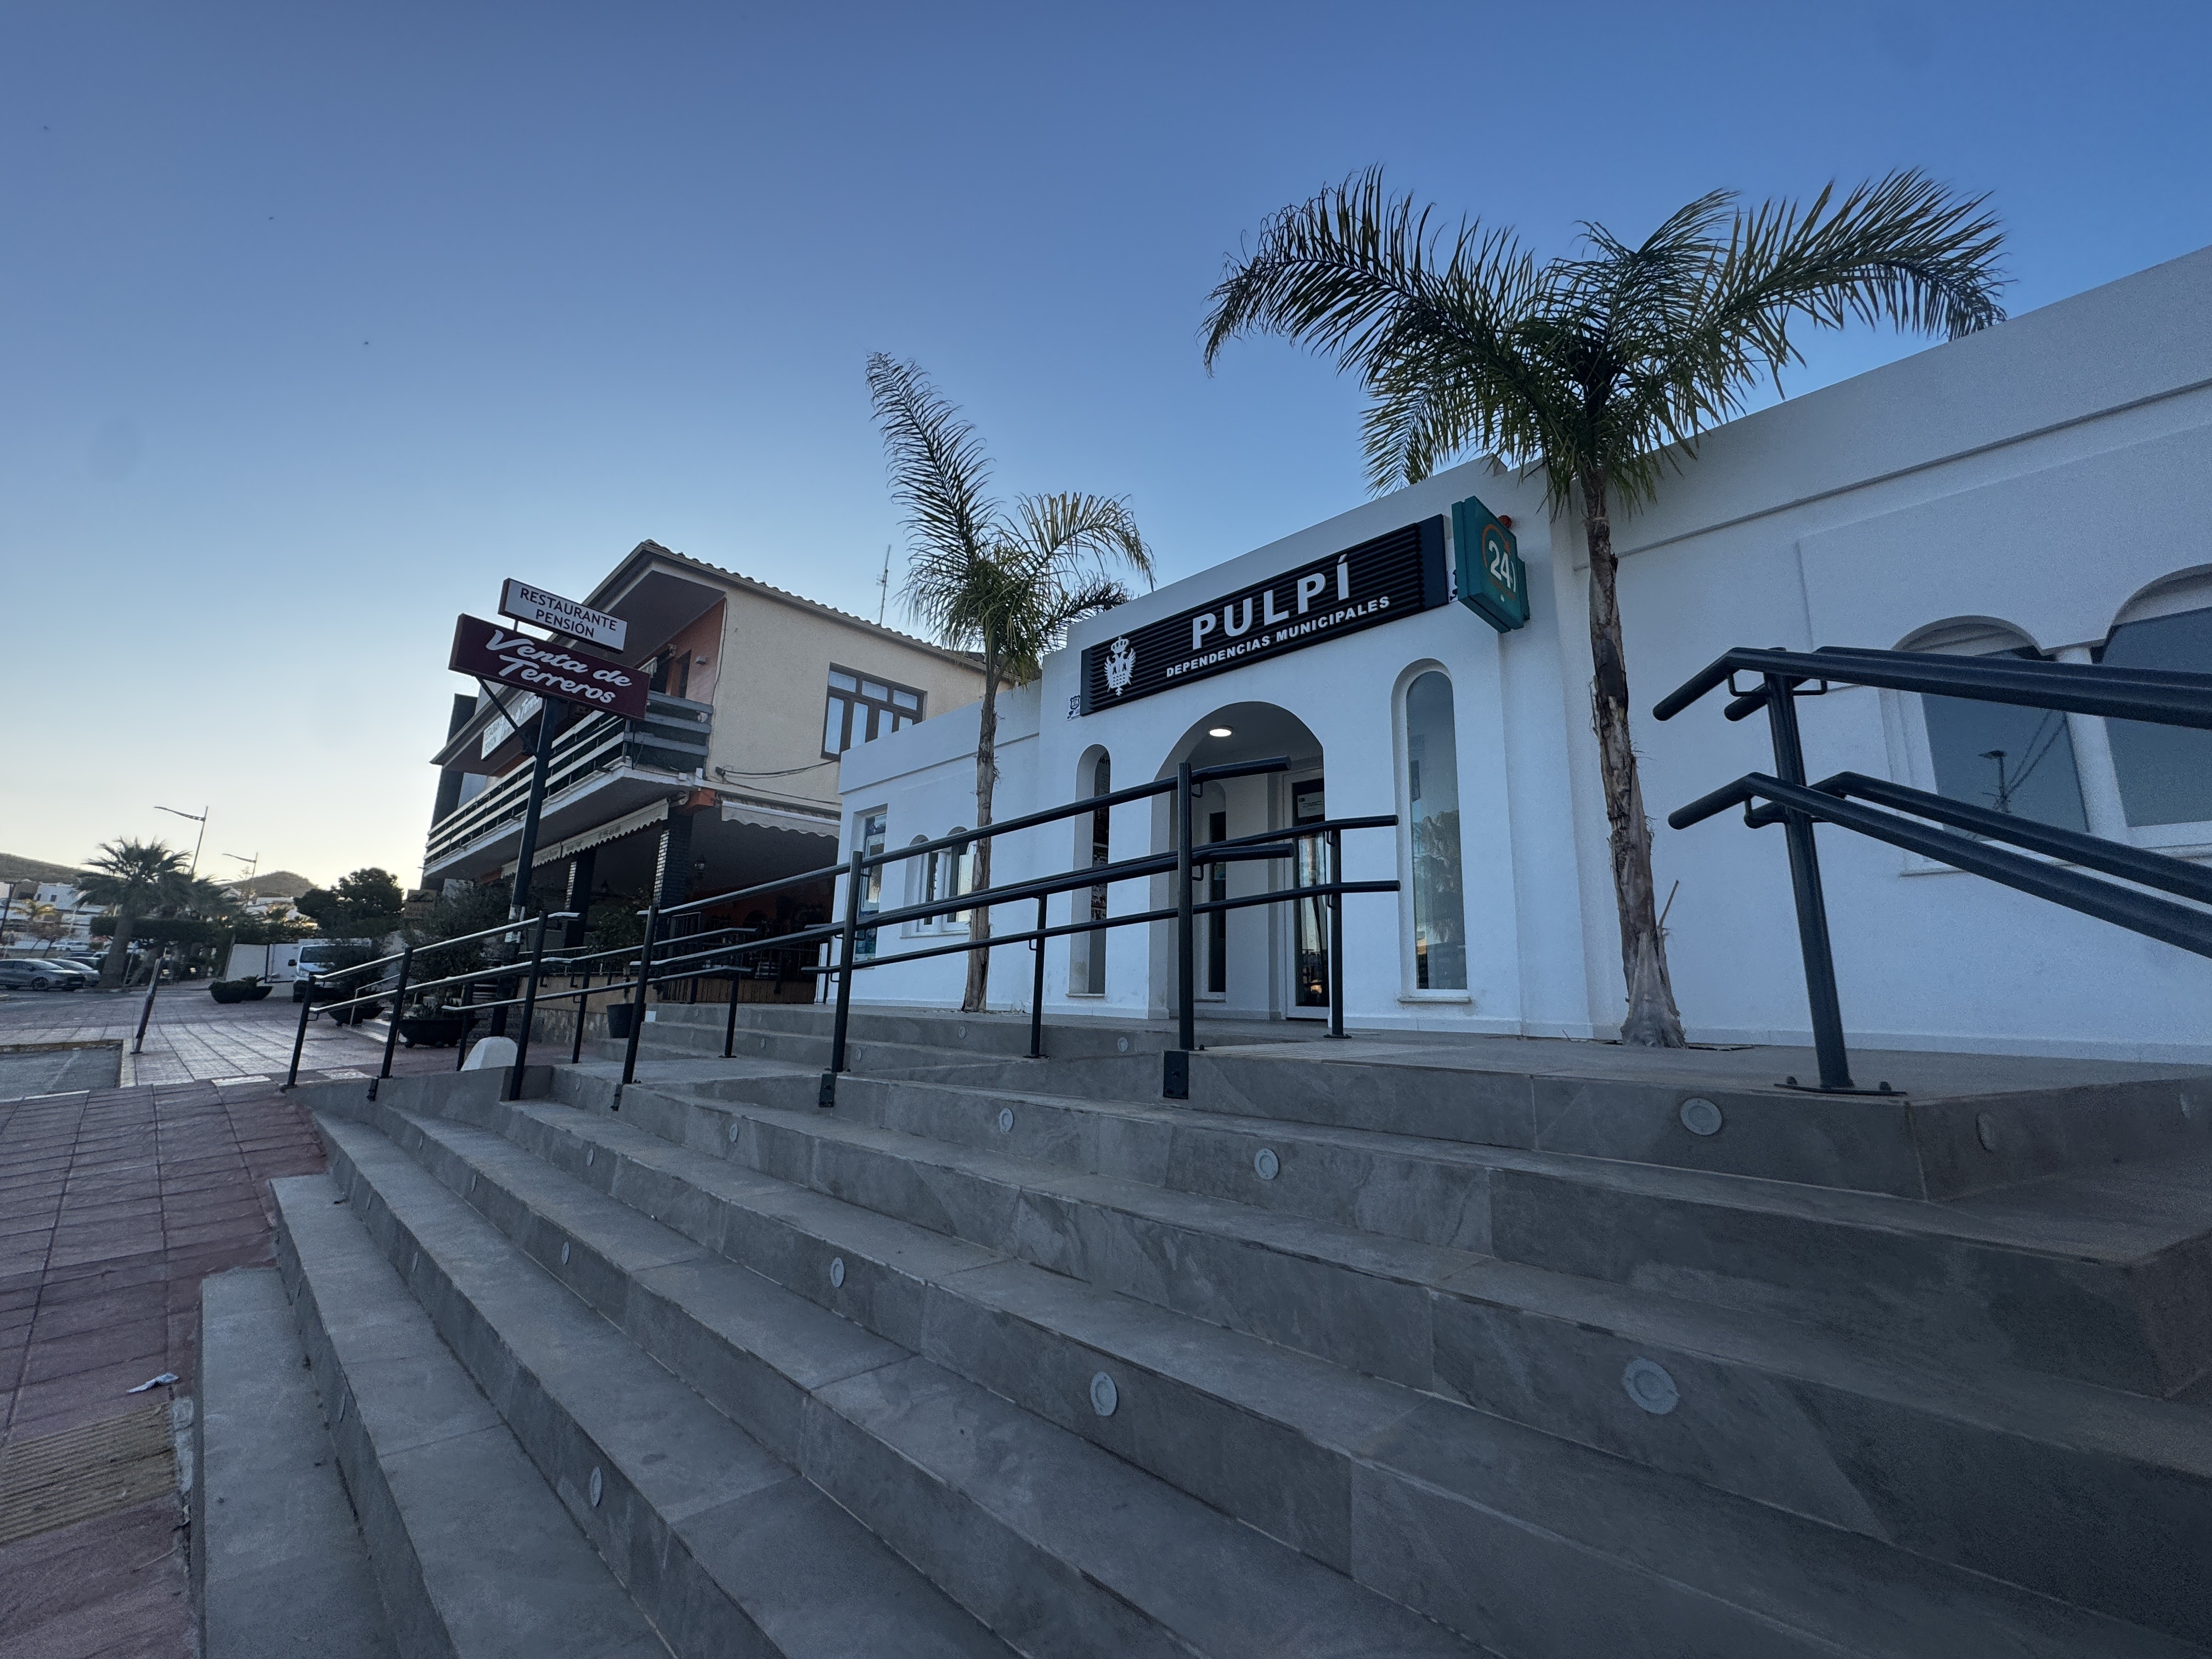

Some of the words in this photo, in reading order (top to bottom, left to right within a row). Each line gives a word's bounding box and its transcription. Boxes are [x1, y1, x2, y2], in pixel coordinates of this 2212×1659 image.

[520, 587, 618, 631] RESTAURANTE
[535, 608, 595, 639] PENSIÓN
[1192, 554, 1350, 650] PULPÍ
[486, 629, 589, 674] Venta
[592, 667, 632, 687] de
[1166, 635, 1271, 678] DEPENDENCIAS
[1276, 596, 1391, 642] MUNICIPALES
[499, 654, 616, 703] Terreros
